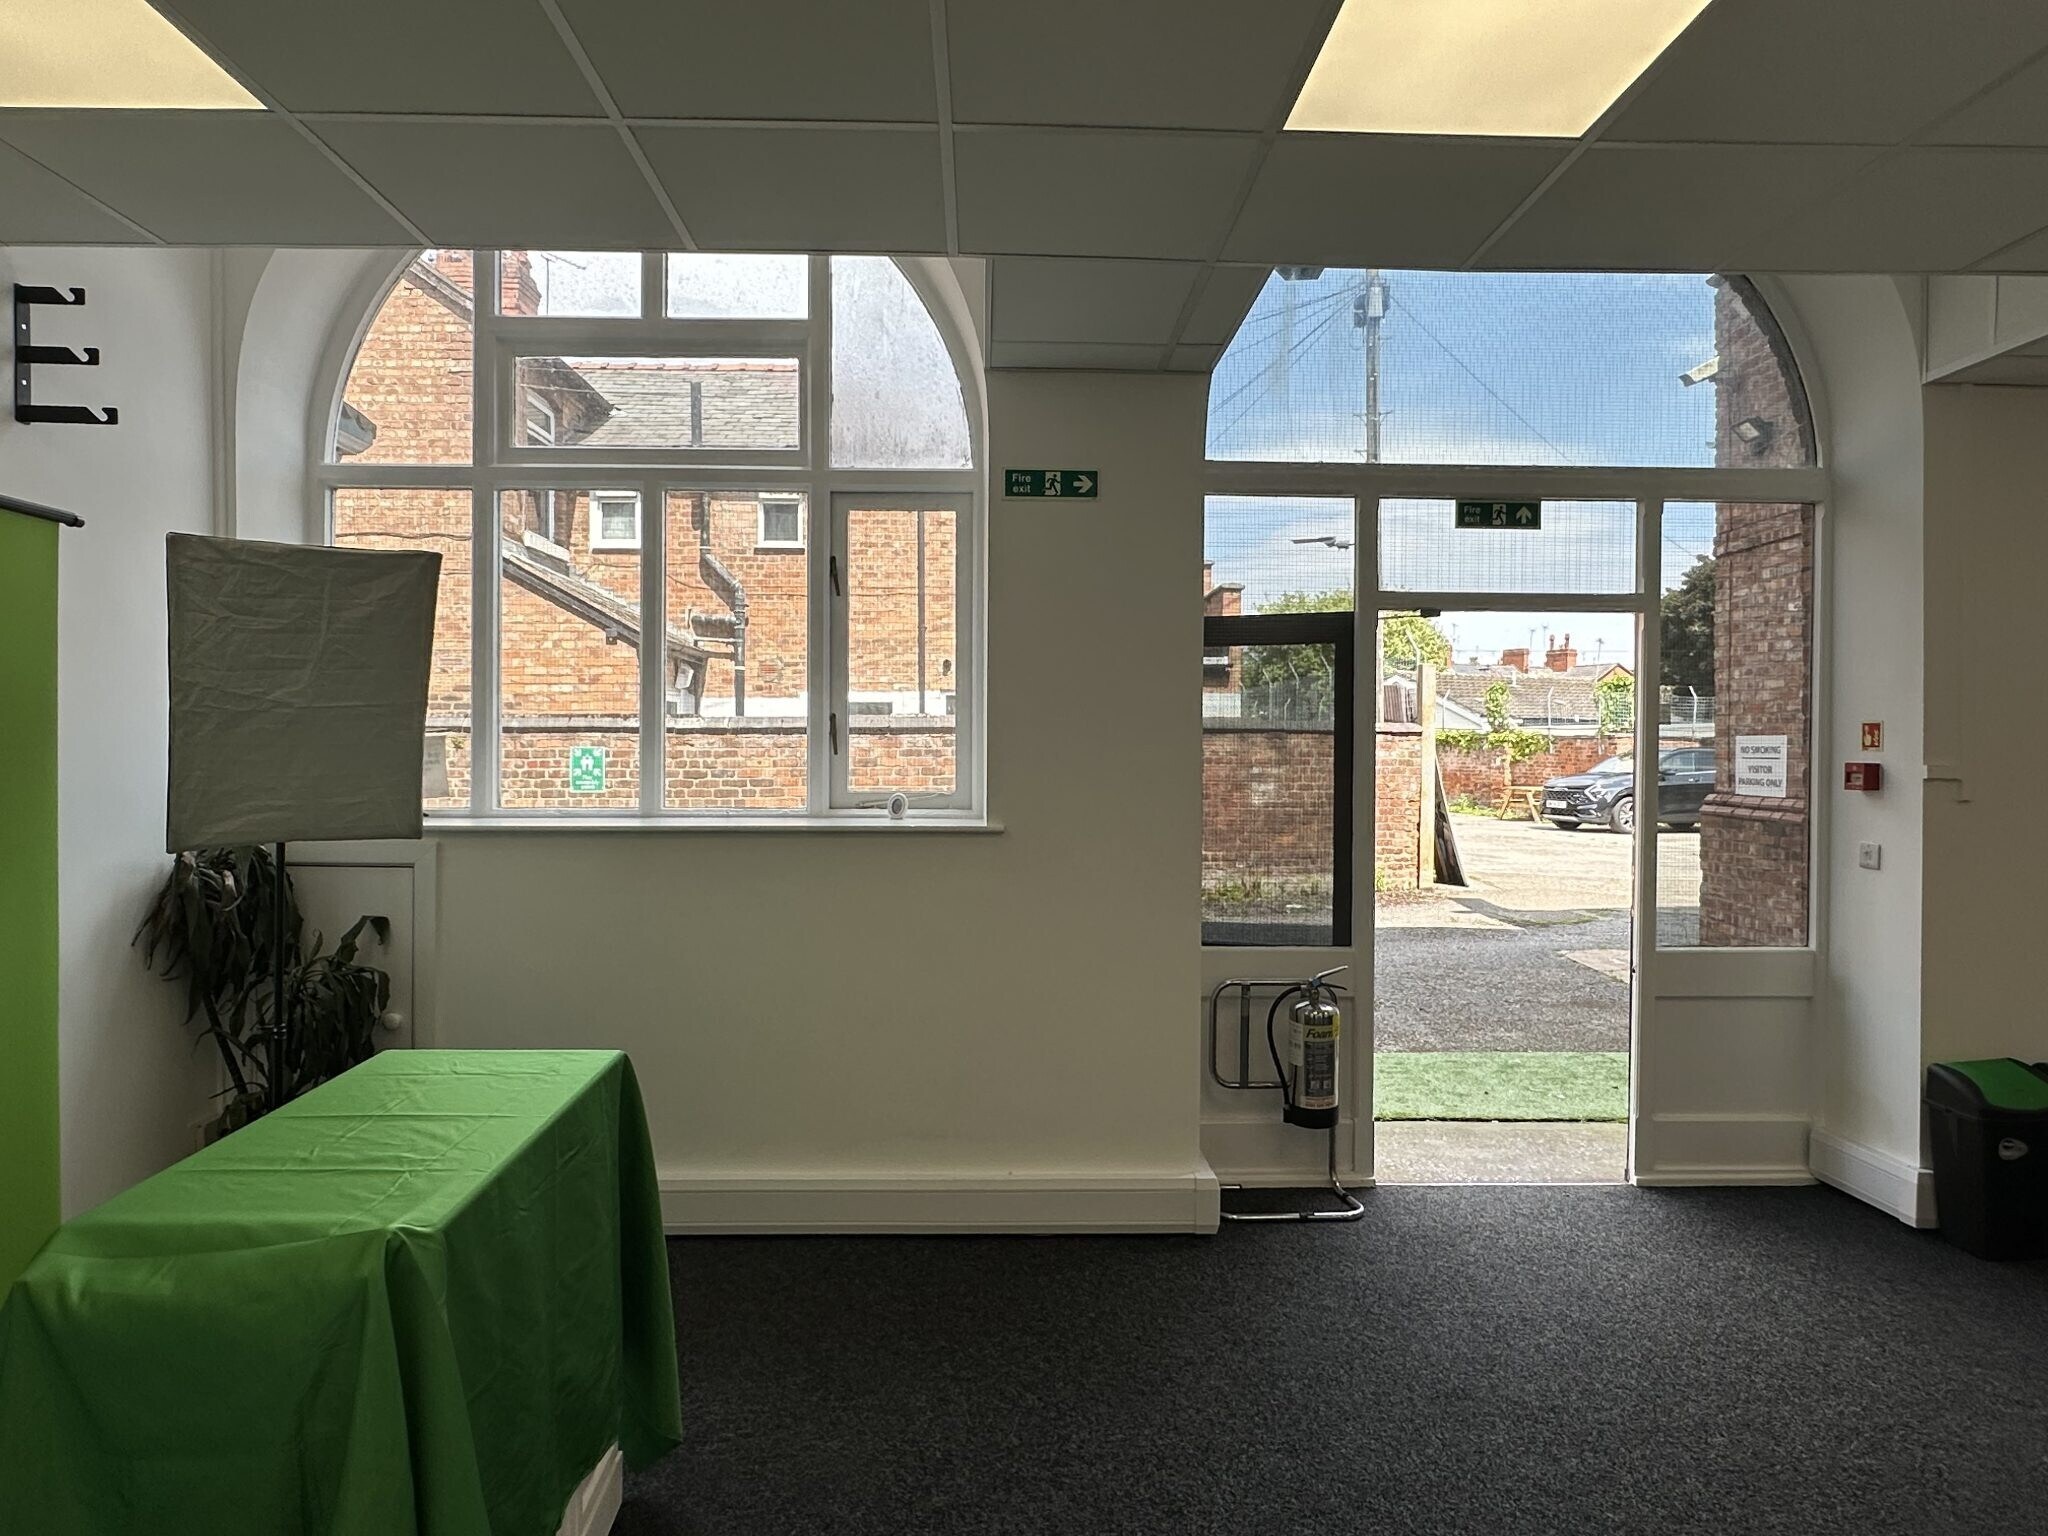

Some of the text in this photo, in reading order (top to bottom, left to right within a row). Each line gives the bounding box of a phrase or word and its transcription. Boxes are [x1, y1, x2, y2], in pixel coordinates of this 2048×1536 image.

[1012, 473, 1031, 482] Fire
[1012, 485, 1031, 493] exit
[1464, 506, 1480, 514] Fire
[1464, 515, 1480, 523] exit
[1751, 746, 1781, 754] SMOKING
[1739, 778, 1782, 787] PARKING ONLY
